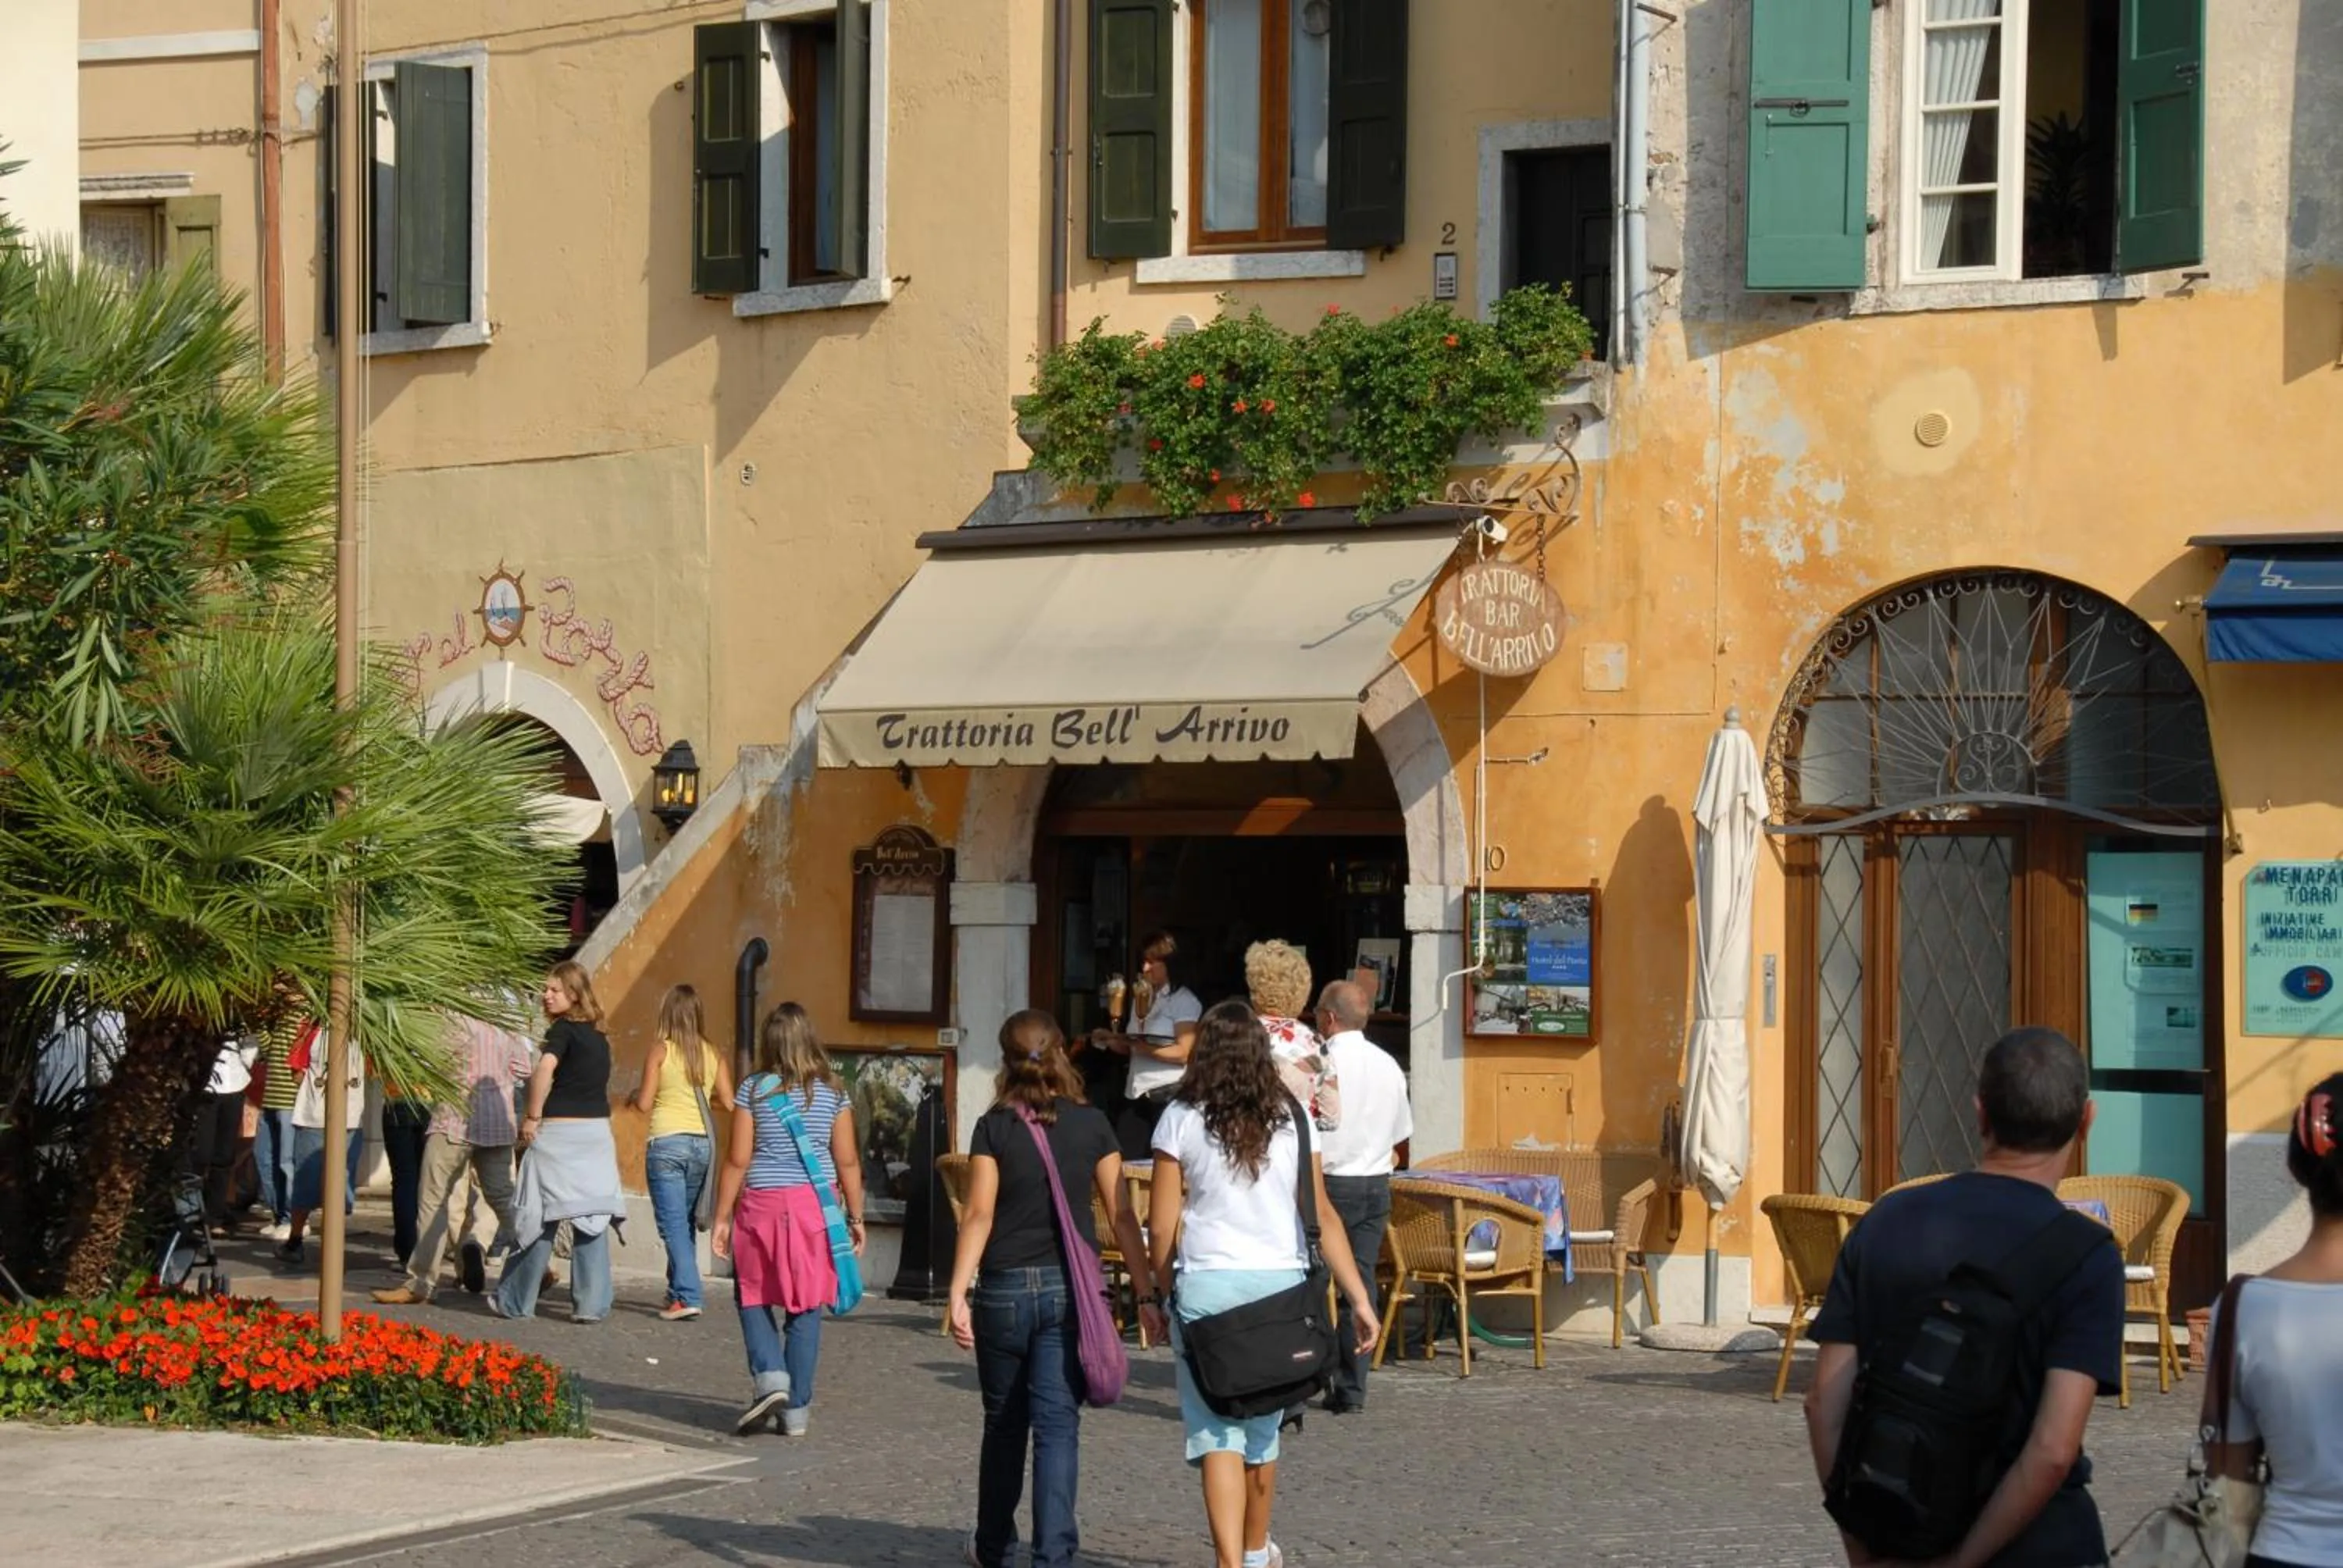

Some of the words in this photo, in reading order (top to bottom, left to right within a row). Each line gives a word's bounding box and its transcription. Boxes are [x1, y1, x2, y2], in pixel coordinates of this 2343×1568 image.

[1441, 221, 1457, 245] 2
[1460, 567, 1546, 614] TRATTORIA
[1485, 599, 1521, 628] BAR
[876, 711, 1035, 749] Trattoria
[1051, 704, 1141, 749] Bell'
[1155, 705, 1290, 743] Arrivo
[2265, 867, 2343, 884] MENAPA
[2287, 886, 2338, 904] TORRI
[2260, 912, 2325, 925] INIZIATIVE
